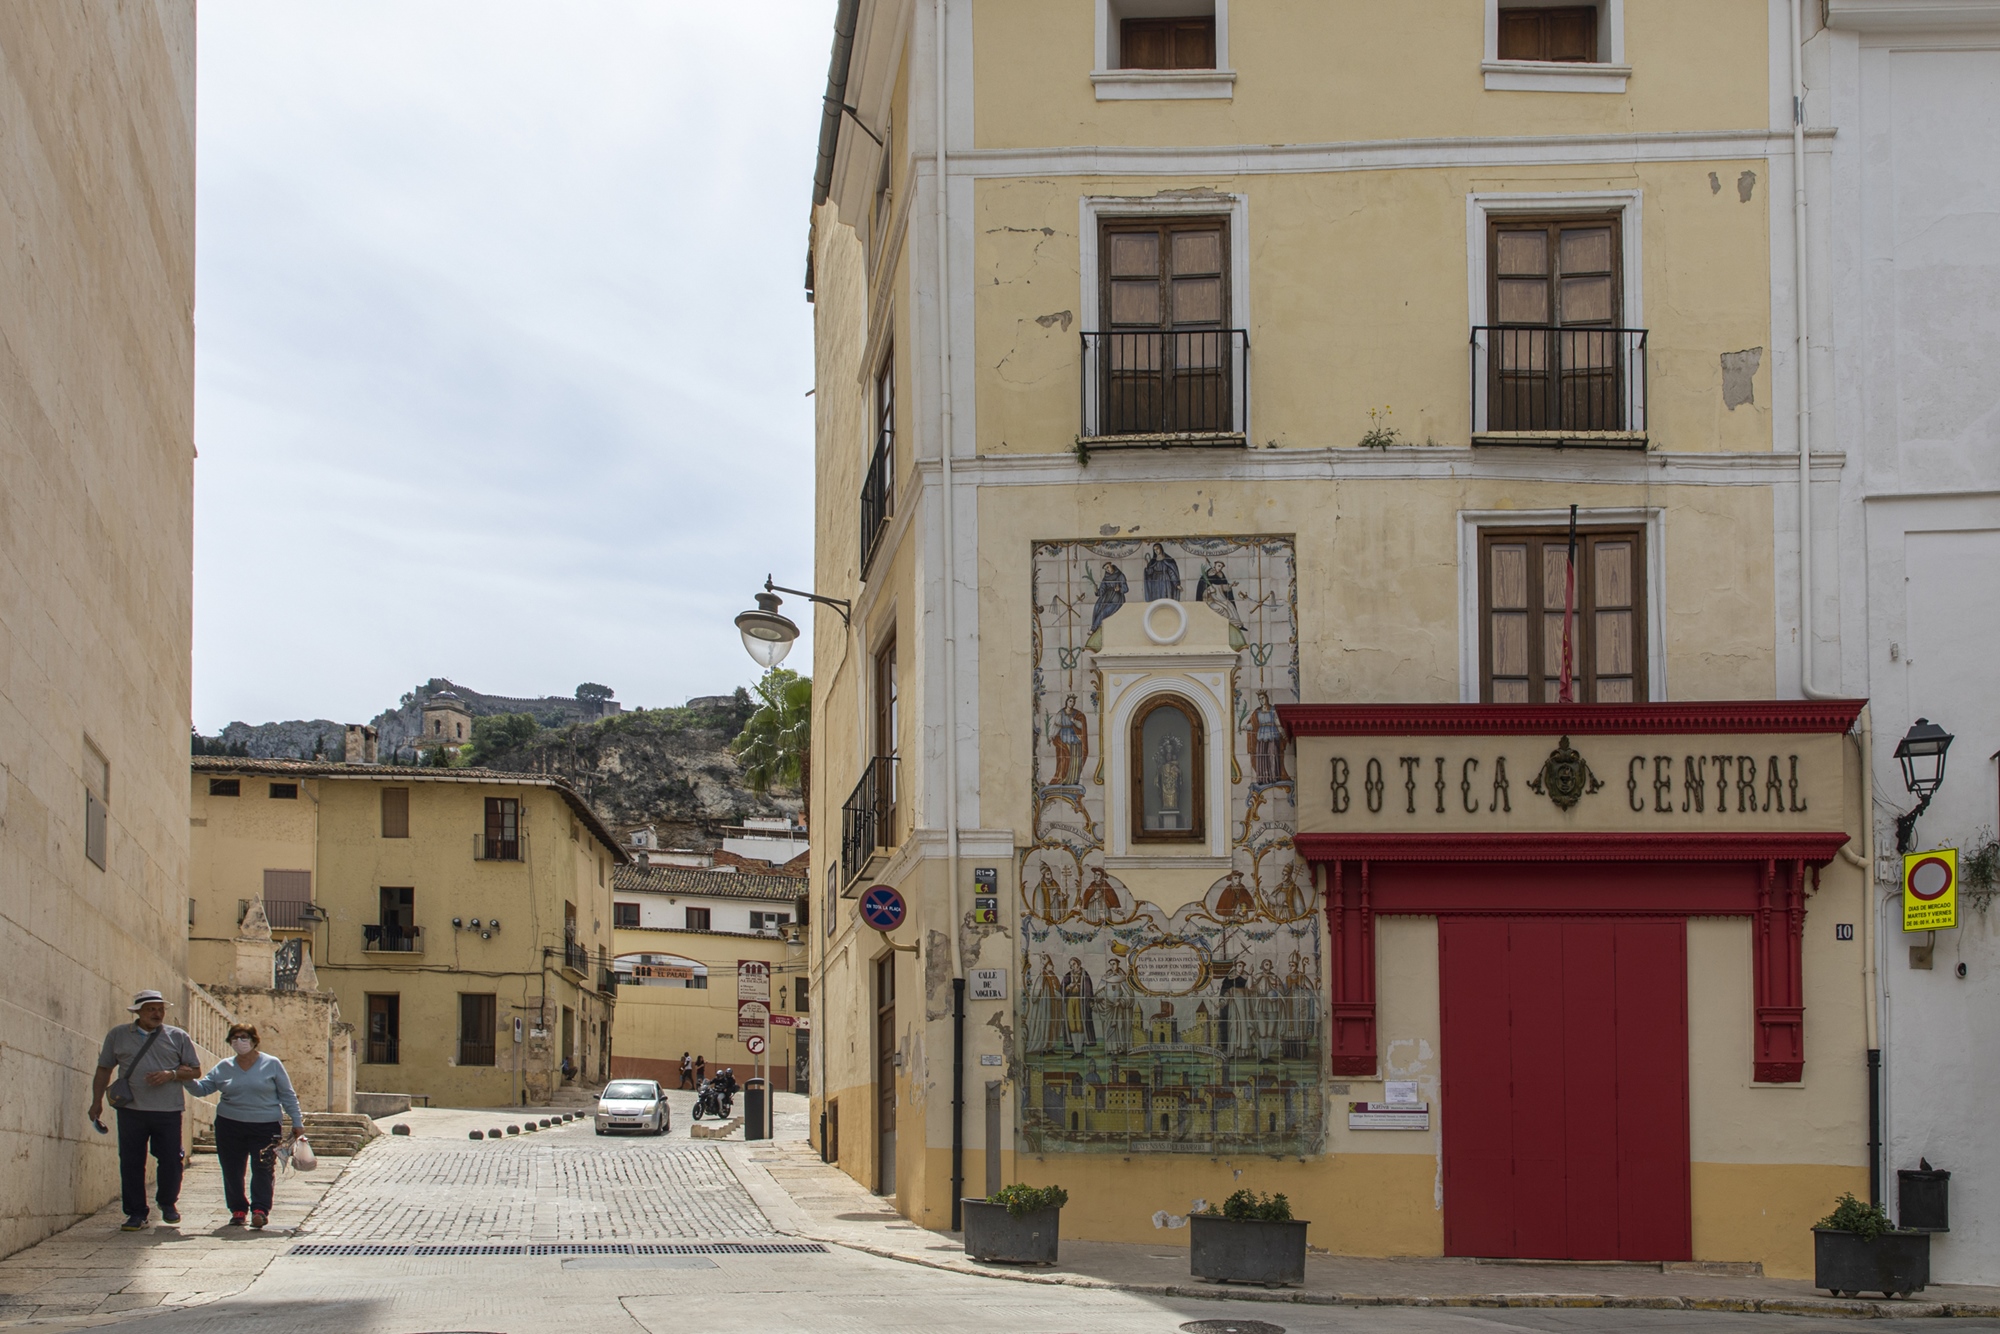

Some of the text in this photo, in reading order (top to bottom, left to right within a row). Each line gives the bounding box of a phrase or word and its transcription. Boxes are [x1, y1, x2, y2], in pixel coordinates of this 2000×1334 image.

[1330, 754, 1808, 814] BOTICA CENTRAL
[1927, 902, 1951, 910] MERCADO
[1907, 911, 1927, 919] MARTES
[1932, 909, 1952, 917] VIERNES
[1837, 924, 1852, 939] 10
[978, 971, 998, 979] CALLE
[975, 989, 1003, 998] NOGUERA
[1180, 1143, 1205, 1151] BARRIO
